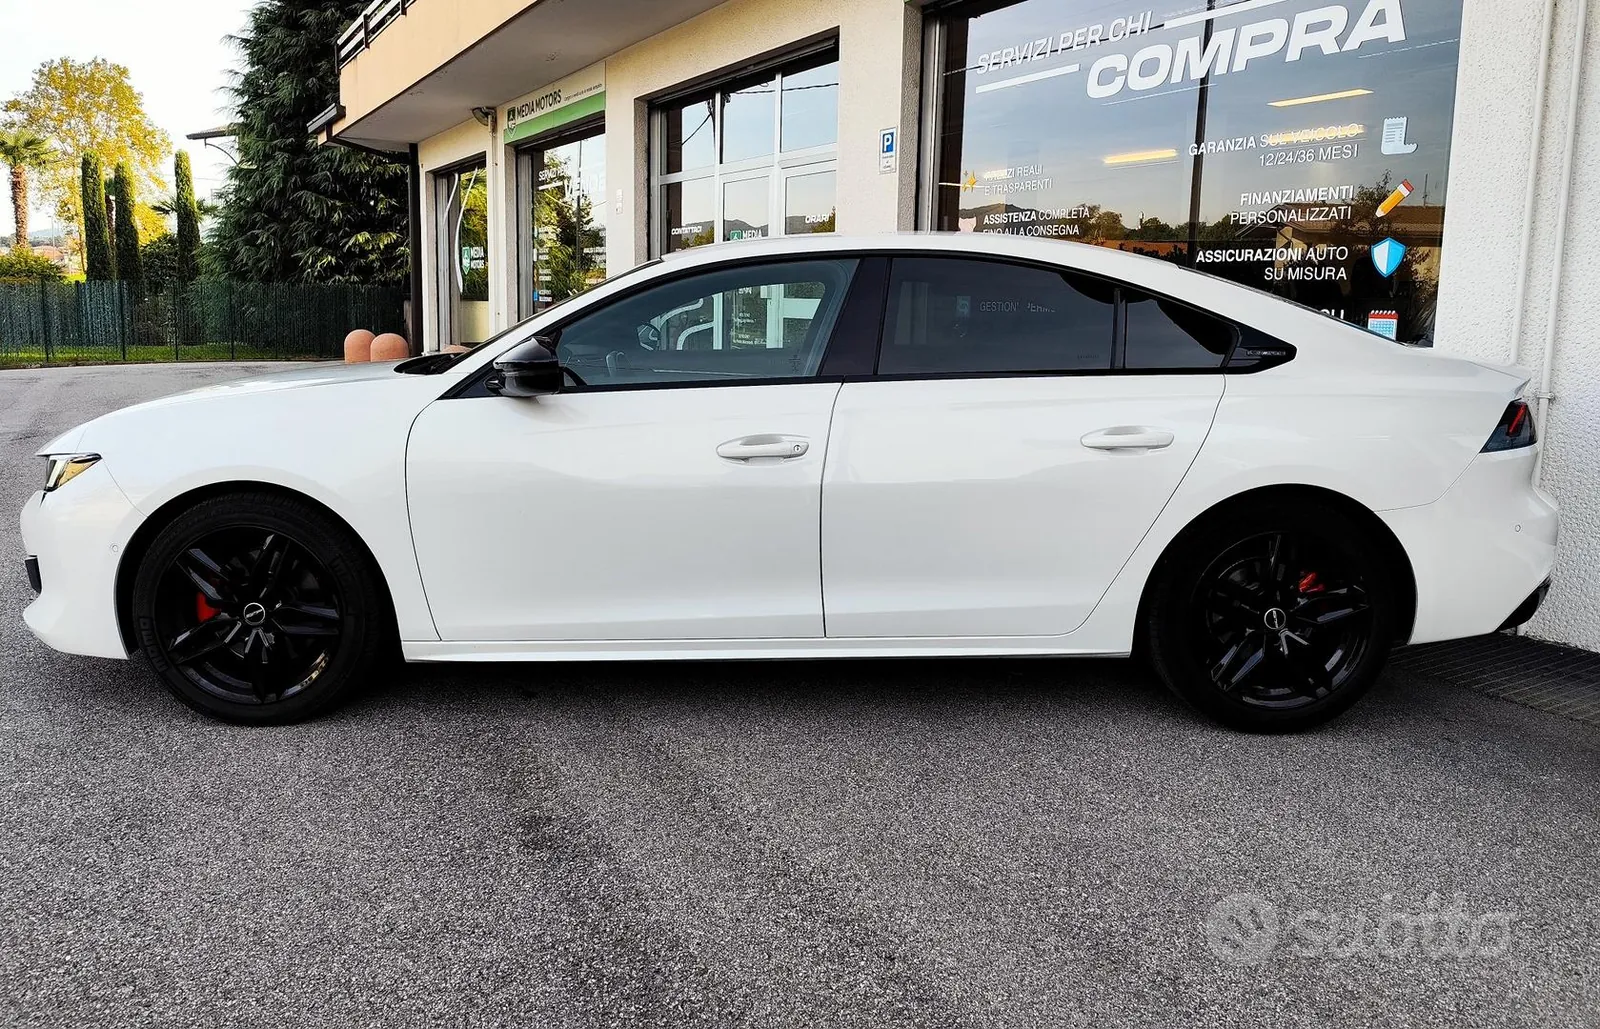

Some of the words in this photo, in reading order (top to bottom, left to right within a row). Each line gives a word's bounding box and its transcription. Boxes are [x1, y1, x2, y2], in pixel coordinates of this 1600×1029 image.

[976, 37, 1055, 75] SERVIZI
[1058, 24, 1104, 55] PER
[1108, 10, 1153, 42] CHI
[1086, 0, 1406, 98] COMPRA
[516, 100, 535, 119] MEDIA
[536, 89, 562, 112] MOTORS
[884, 134, 892, 152] P
[1189, 136, 1257, 156] GARANZIA
[1260, 132, 1291, 148] SUL
[1293, 123, 1359, 143] VEICOLO
[1260, 148, 1315, 166] 12/24/36
[1318, 143, 1359, 160] MESI
[992, 178, 1053, 195] TRASPARENTI
[1240, 185, 1354, 206] FINANZIAMENTI
[805, 213, 830, 224] ORARI
[983, 211, 1036, 225] ASSISTENZA
[1038, 207, 1090, 221] COMPLETA
[1230, 206, 1352, 224] PERSONALIZZATI
[671, 226, 702, 235] CONTATTACI
[743, 229, 762, 240] MEDIA
[1026, 225, 1080, 236] CONSEGNA
[471, 247, 484, 258] MEDIA
[1196, 248, 1301, 263] ASSICURAZIONI
[1305, 246, 1348, 261] AUTO
[1264, 267, 1284, 280] SU
[1287, 266, 1347, 280] MISURA
